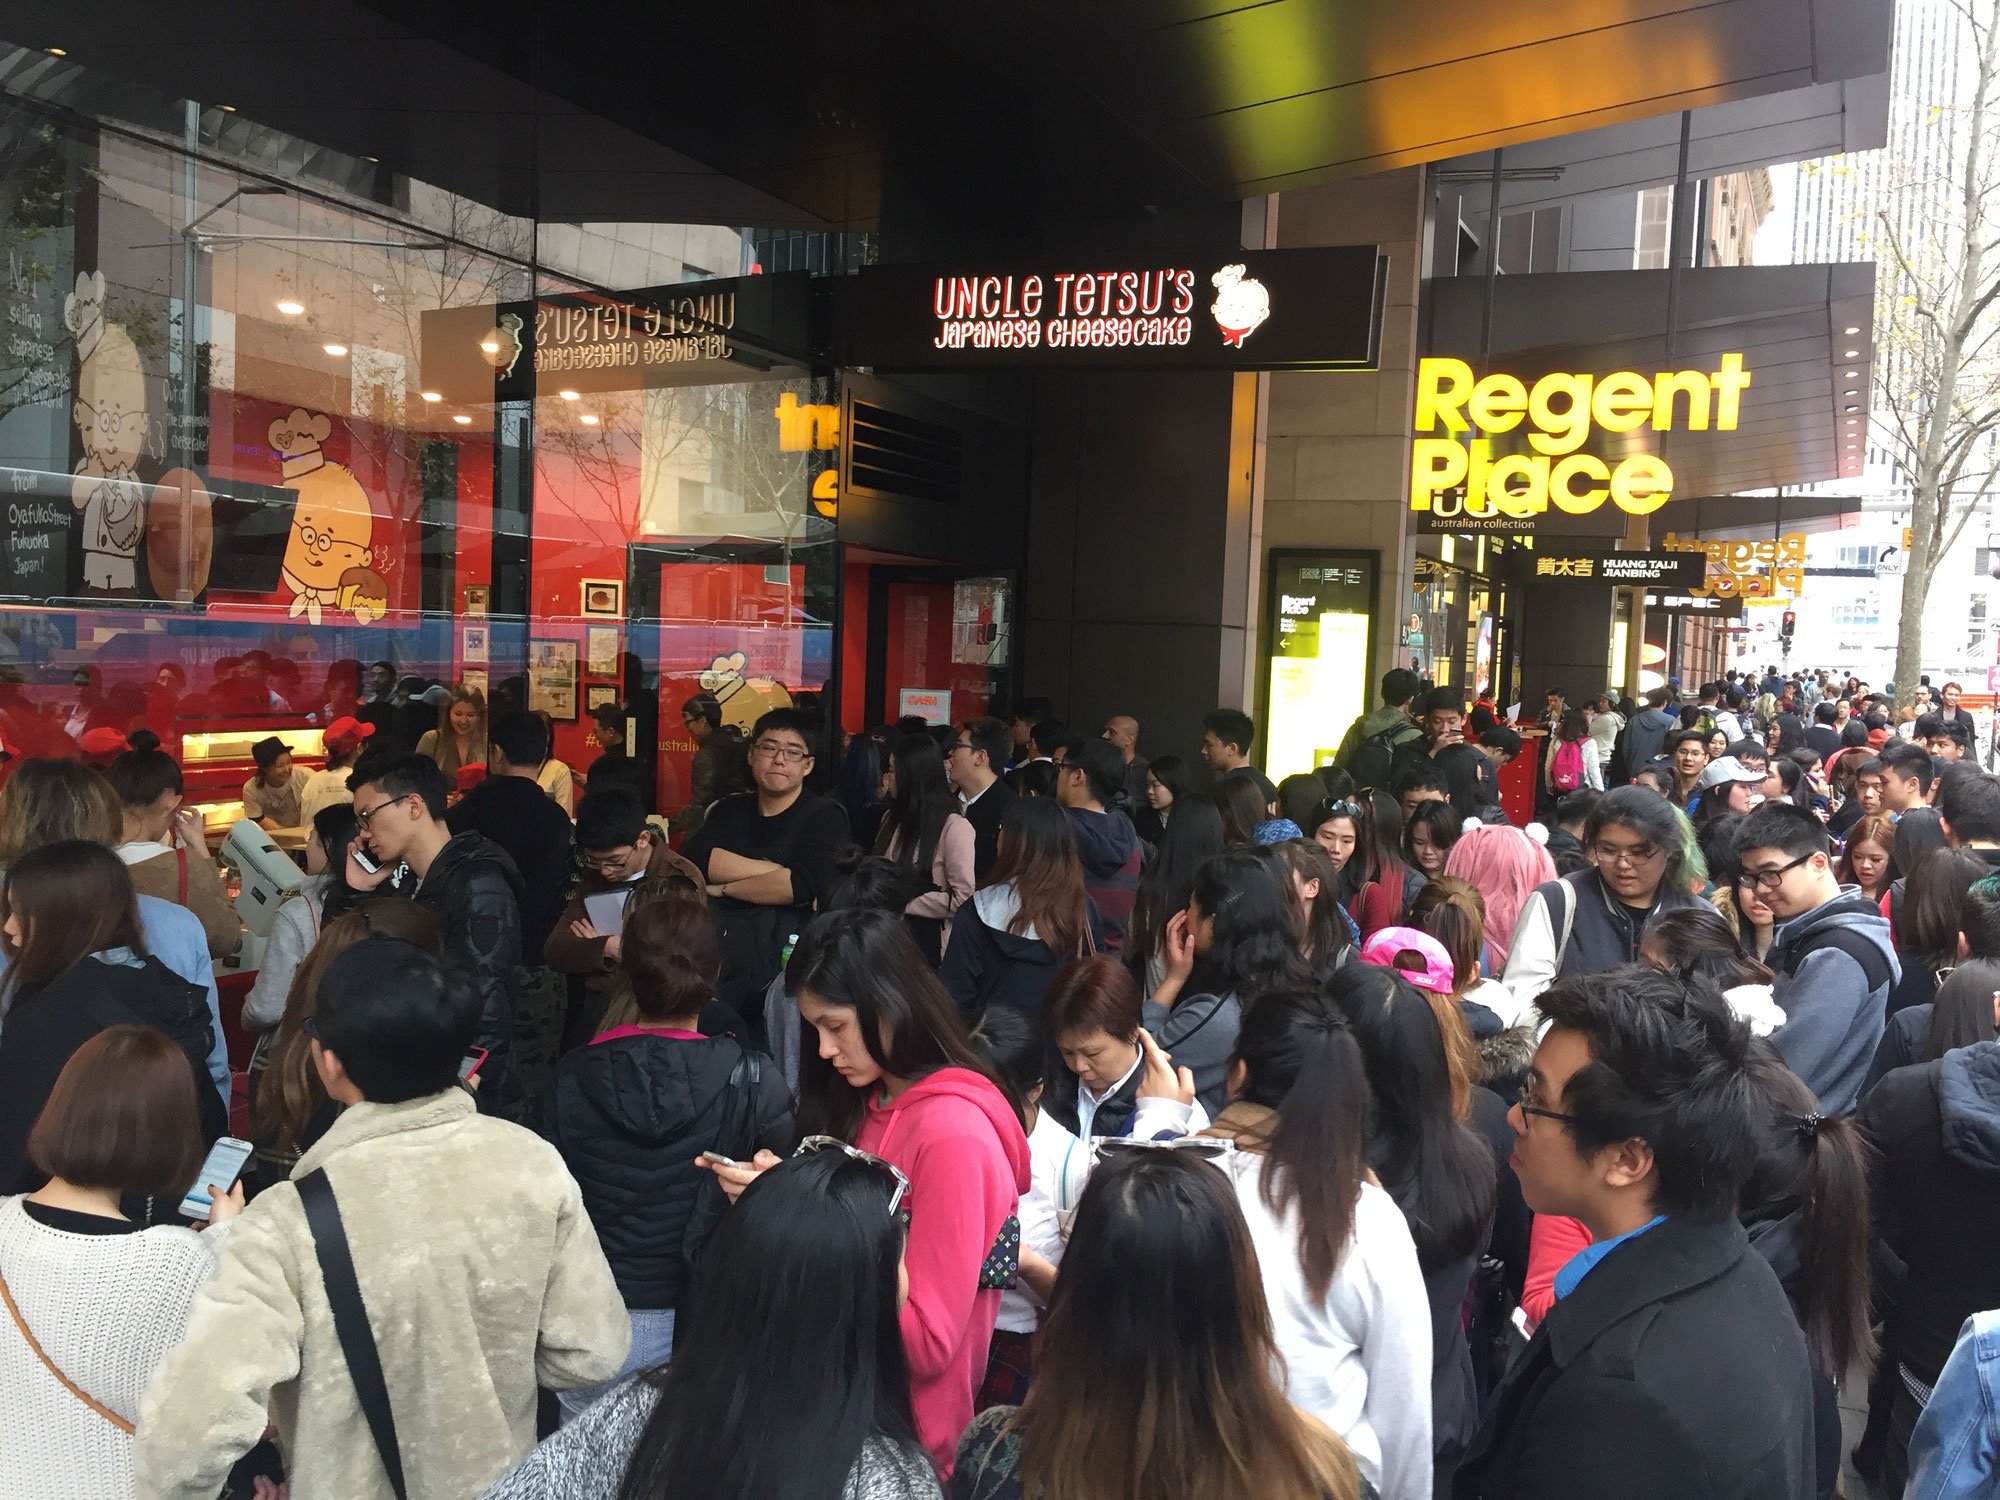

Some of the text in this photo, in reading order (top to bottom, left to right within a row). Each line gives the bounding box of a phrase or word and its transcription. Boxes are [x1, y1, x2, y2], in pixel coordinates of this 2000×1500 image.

[1414, 353, 1752, 456] Regent
[11, 470, 38, 493] from
[1410, 438, 1674, 515] Place
[1431, 518, 1535, 530] australian collection
[11, 530, 49, 551] Fukuoka
[1602, 559, 1678, 570] HUANG TAIJI
[1602, 569, 1661, 579] JIANBING
